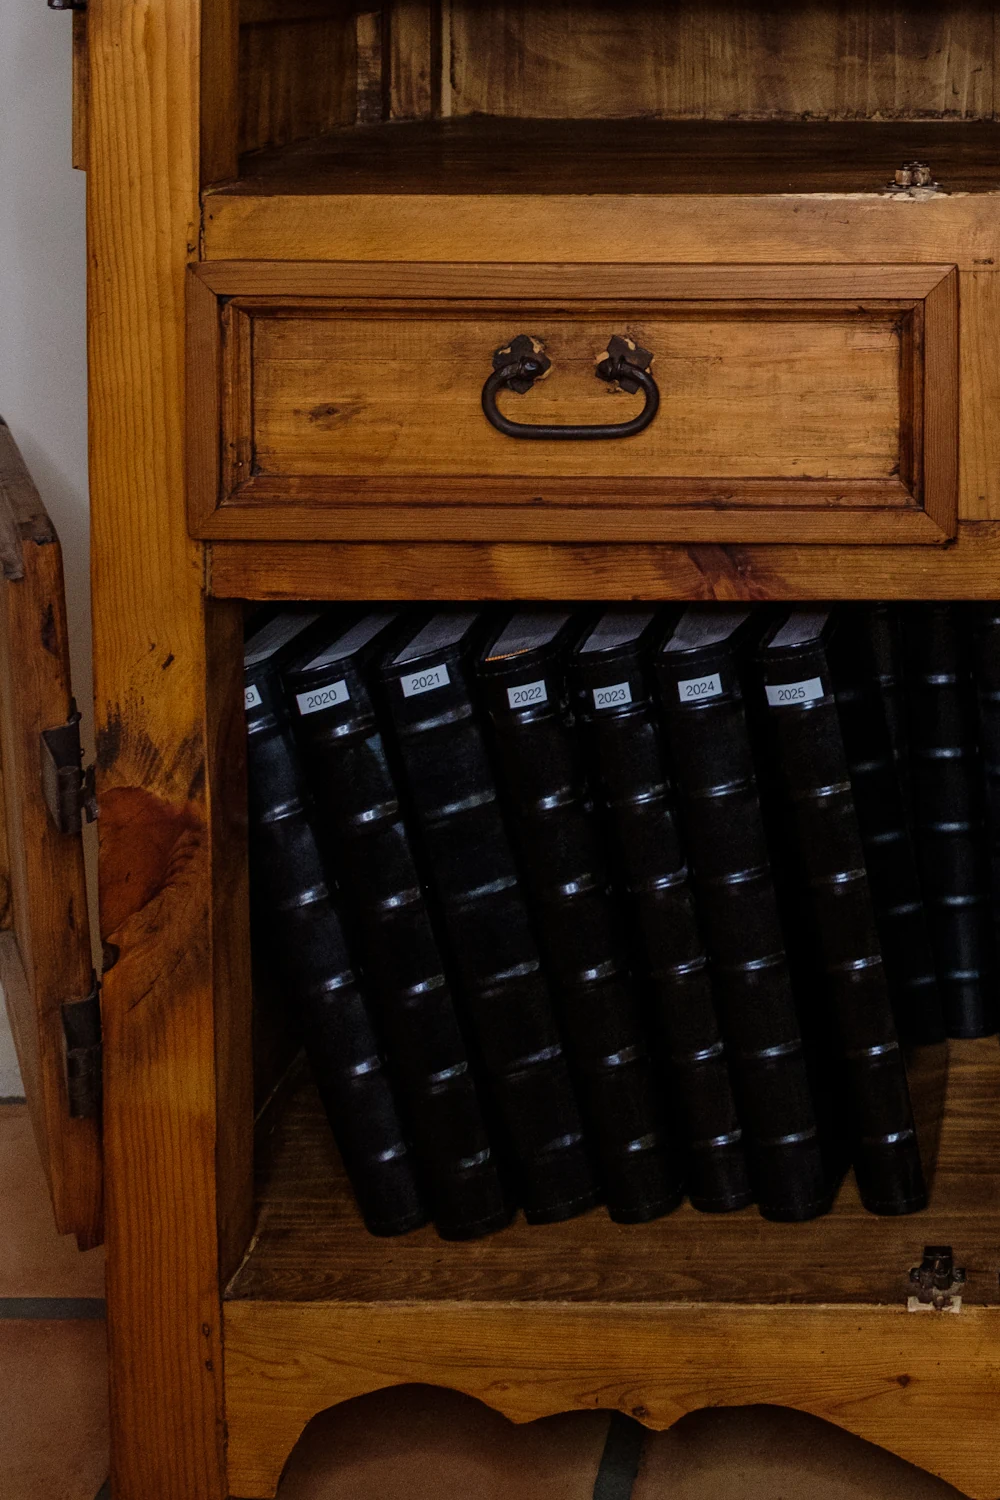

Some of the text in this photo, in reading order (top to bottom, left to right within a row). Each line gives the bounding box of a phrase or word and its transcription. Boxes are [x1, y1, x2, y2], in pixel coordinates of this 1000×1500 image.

[411, 672, 441, 690] 2021
[686, 681, 715, 697] 2024
[307, 689, 337, 708] 2020
[513, 686, 542, 704] 2022
[597, 688, 626, 705] 2023
[777, 686, 806, 701] 2025
